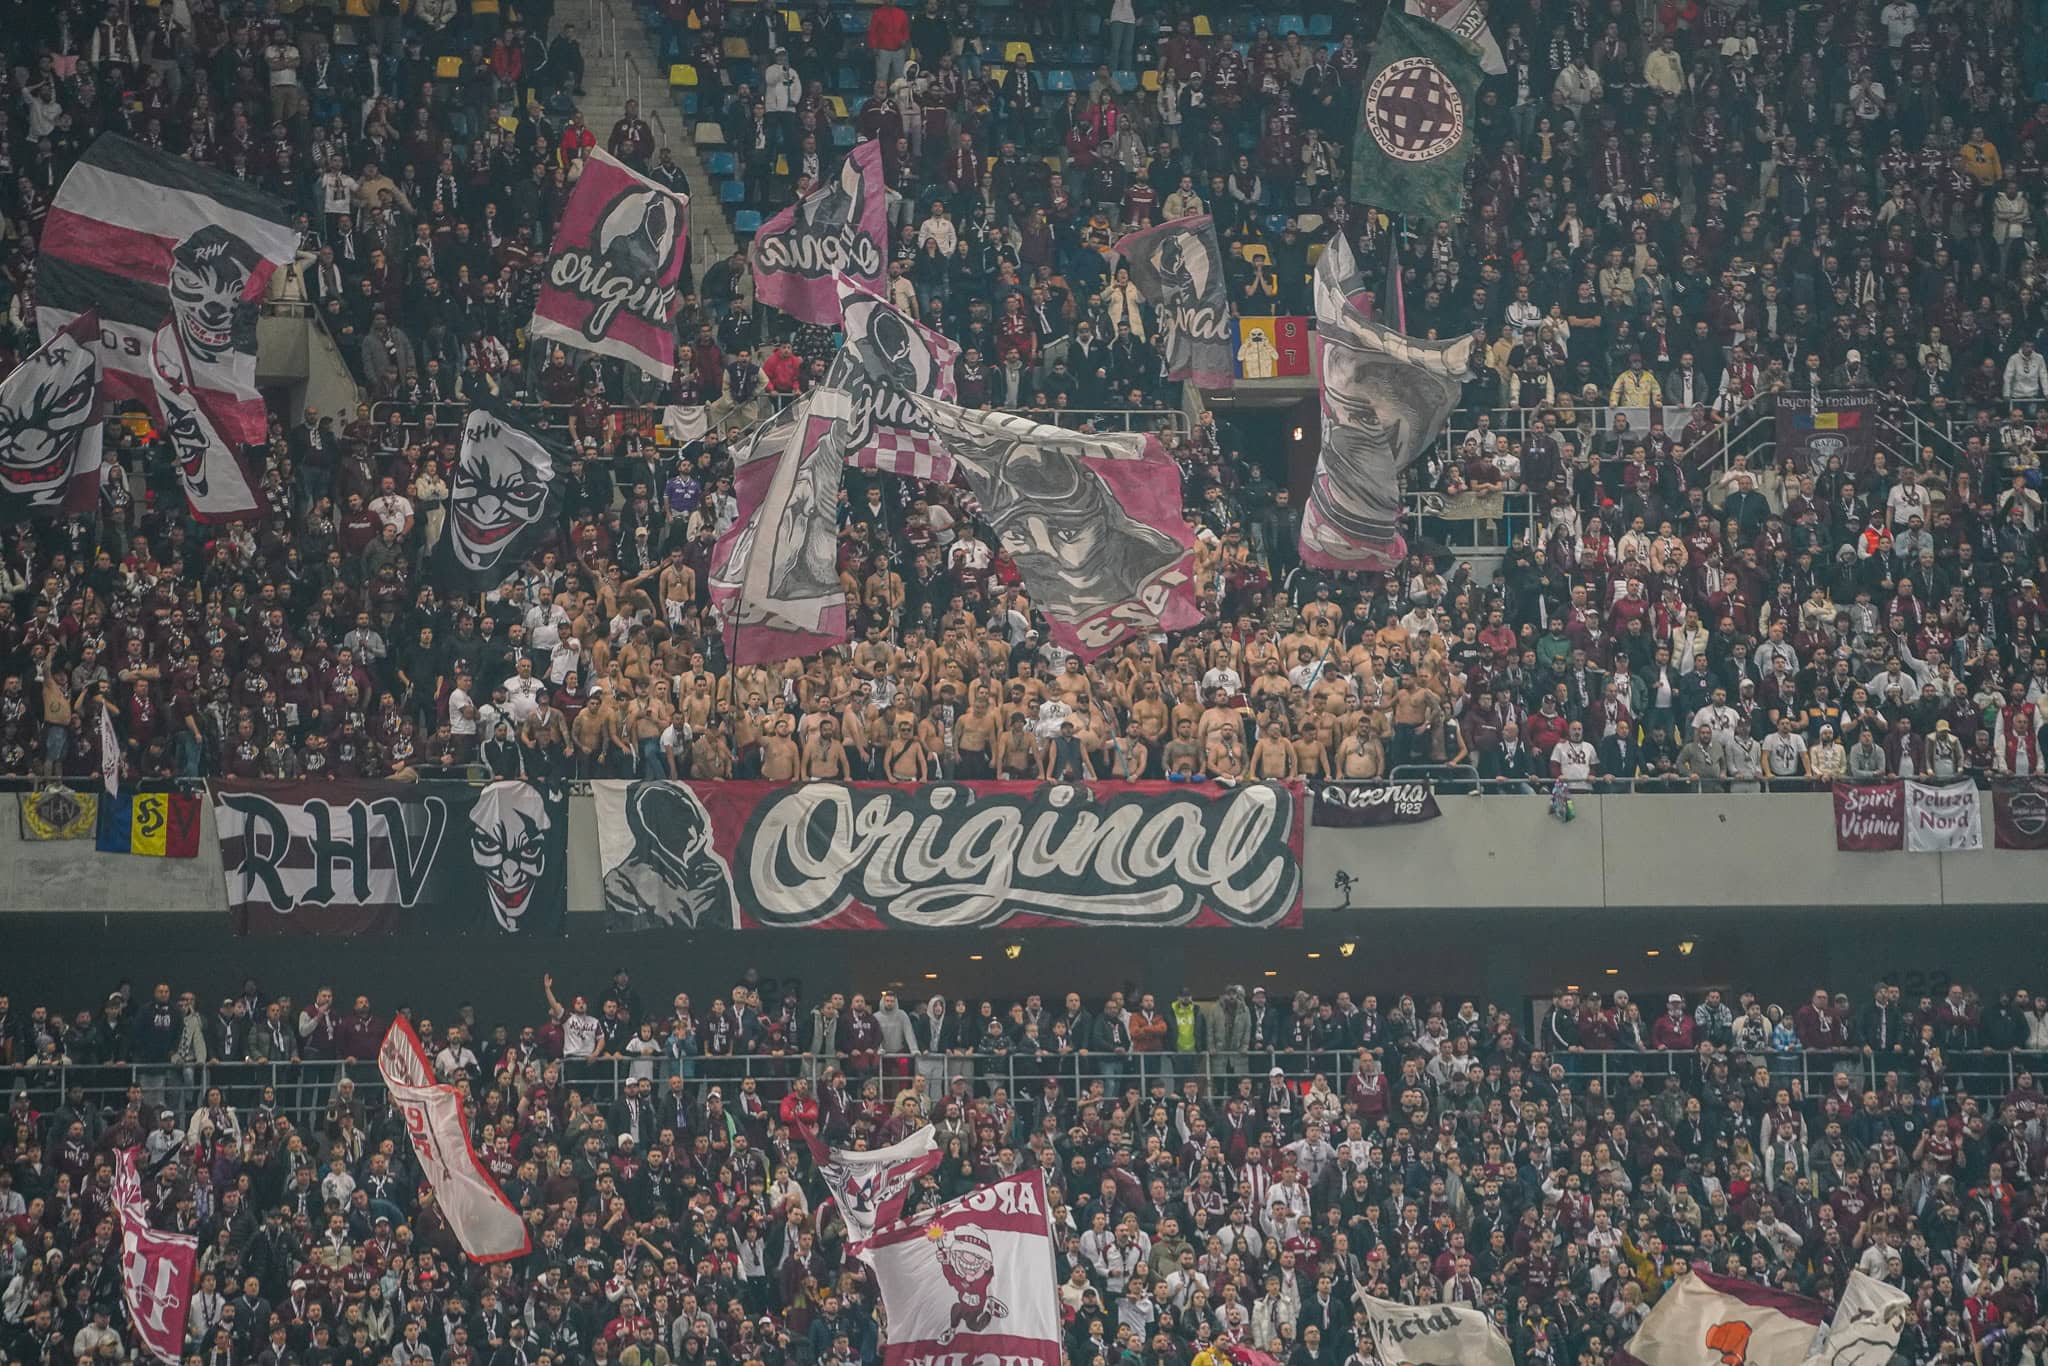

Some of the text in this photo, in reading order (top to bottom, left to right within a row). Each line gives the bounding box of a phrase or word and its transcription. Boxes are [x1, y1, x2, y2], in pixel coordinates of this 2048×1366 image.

[195, 242, 229, 260] RHV
[465, 422, 501, 444] RHV
[1393, 802, 1423, 815] 1923
[1844, 789, 1897, 812] Spirit
[1912, 790, 1973, 807] Peluza
[1919, 811, 1969, 829] Nord
[217, 791, 448, 913] RHV
[749, 783, 1297, 927] Original
